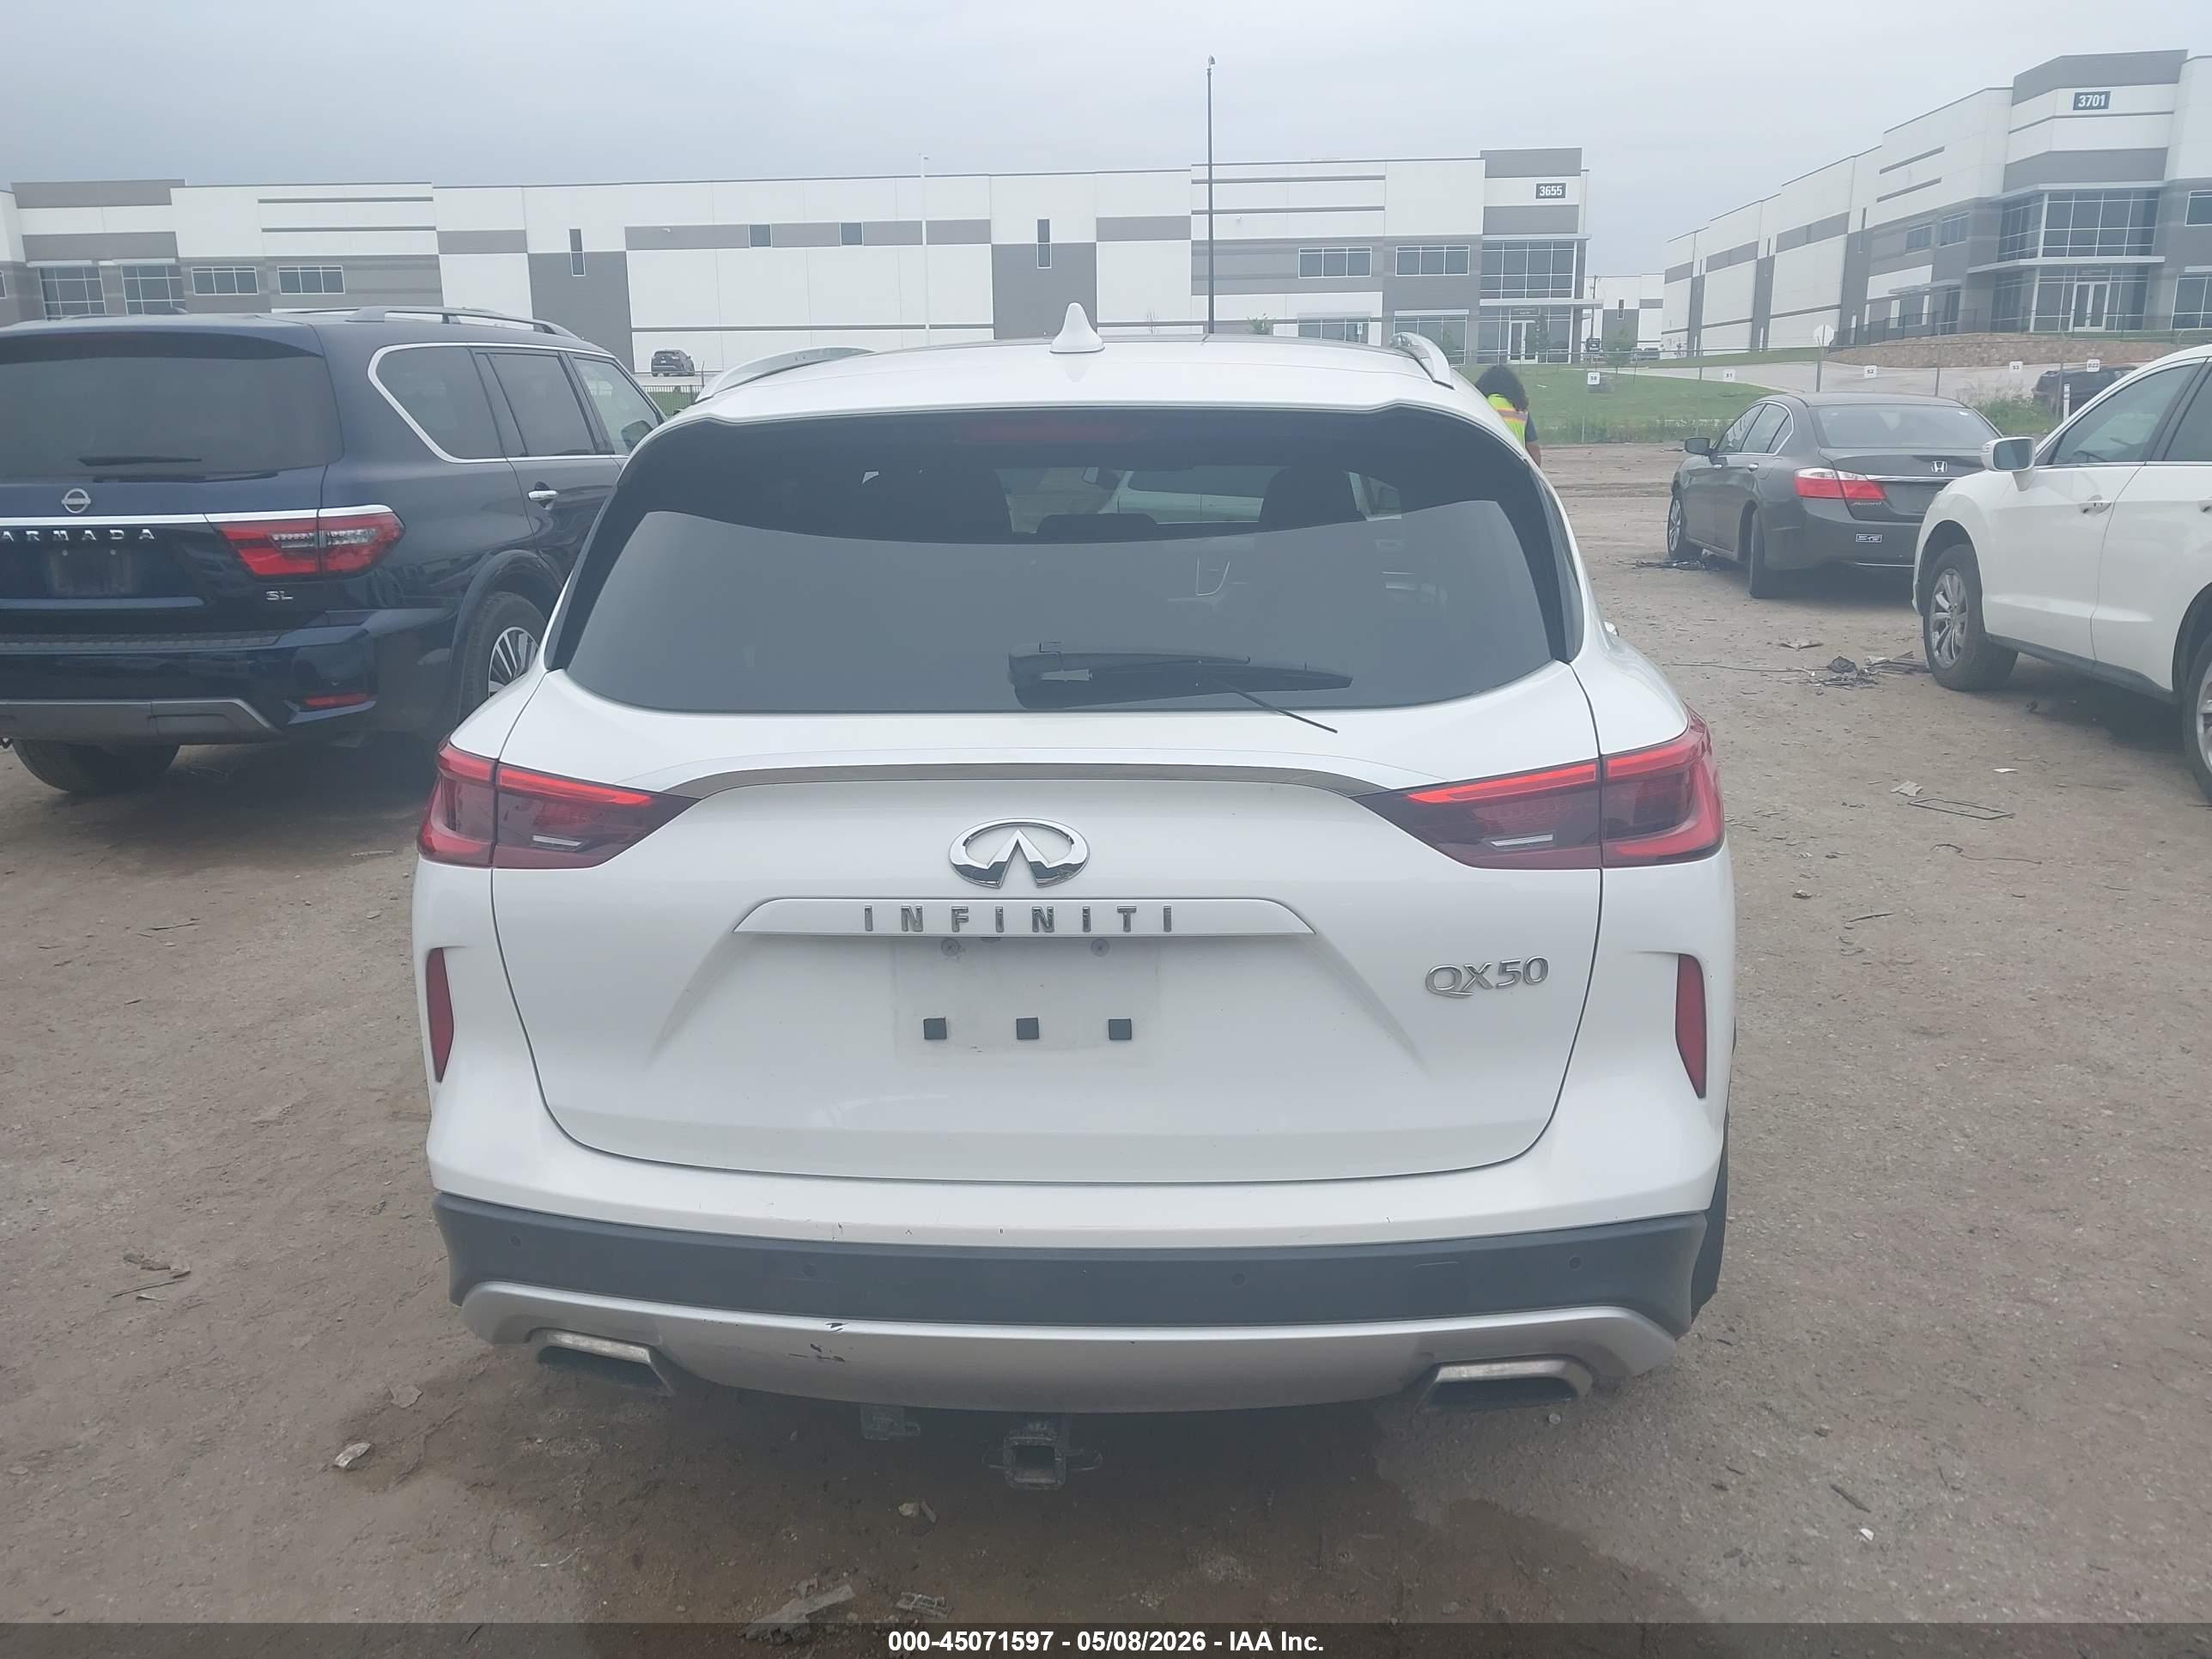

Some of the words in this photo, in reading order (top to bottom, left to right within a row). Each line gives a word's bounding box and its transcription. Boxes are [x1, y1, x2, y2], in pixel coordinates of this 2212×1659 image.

[2078, 94, 2106, 107] 3701
[1539, 185, 1563, 197] 3655
[2, 528, 155, 542] ARMADA
[266, 590, 294, 601] SL
[864, 904, 1173, 933] INFINITI
[1425, 955, 1549, 1000] QX50
